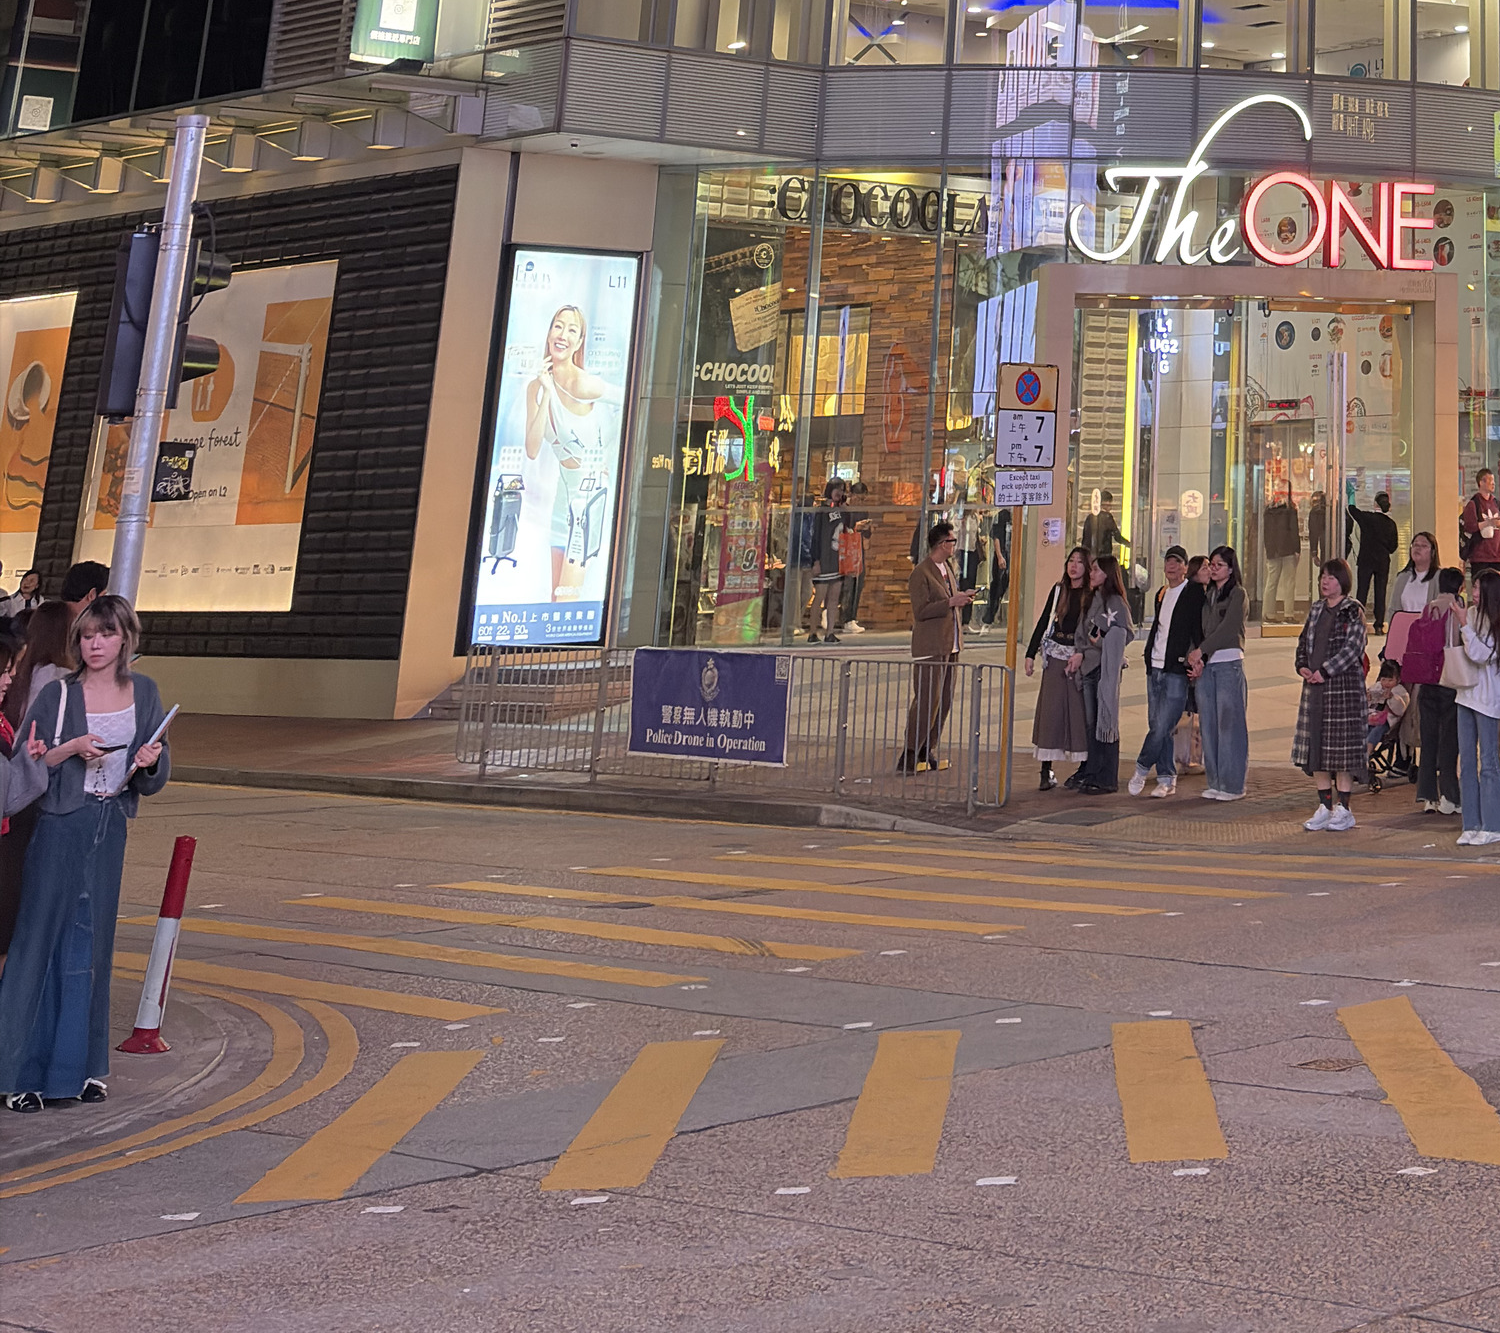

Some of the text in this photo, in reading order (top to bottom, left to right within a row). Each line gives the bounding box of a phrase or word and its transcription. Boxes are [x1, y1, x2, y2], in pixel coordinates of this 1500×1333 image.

[1069, 93, 1437, 271] The ONE
[608, 275, 627, 289] L11
[1157, 318, 1173, 332] L1
[1009, 416, 1045, 433] 上午 7
[208, 427, 242, 451] forest
[1008, 445, 1044, 463] 下午 7
[1011, 443, 1022, 451] pm
[1009, 474, 1029, 482] Except
[219, 487, 228, 497] L2
[1014, 482, 1038, 491] up/drop
[1039, 481, 1048, 489] off
[998, 492, 1050, 503] 的士上落客除外
[502, 610, 527, 624] No.1
[661, 706, 755, 730] 警察無人機執勤中
[646, 728, 766, 752] Police Drone in Operation
